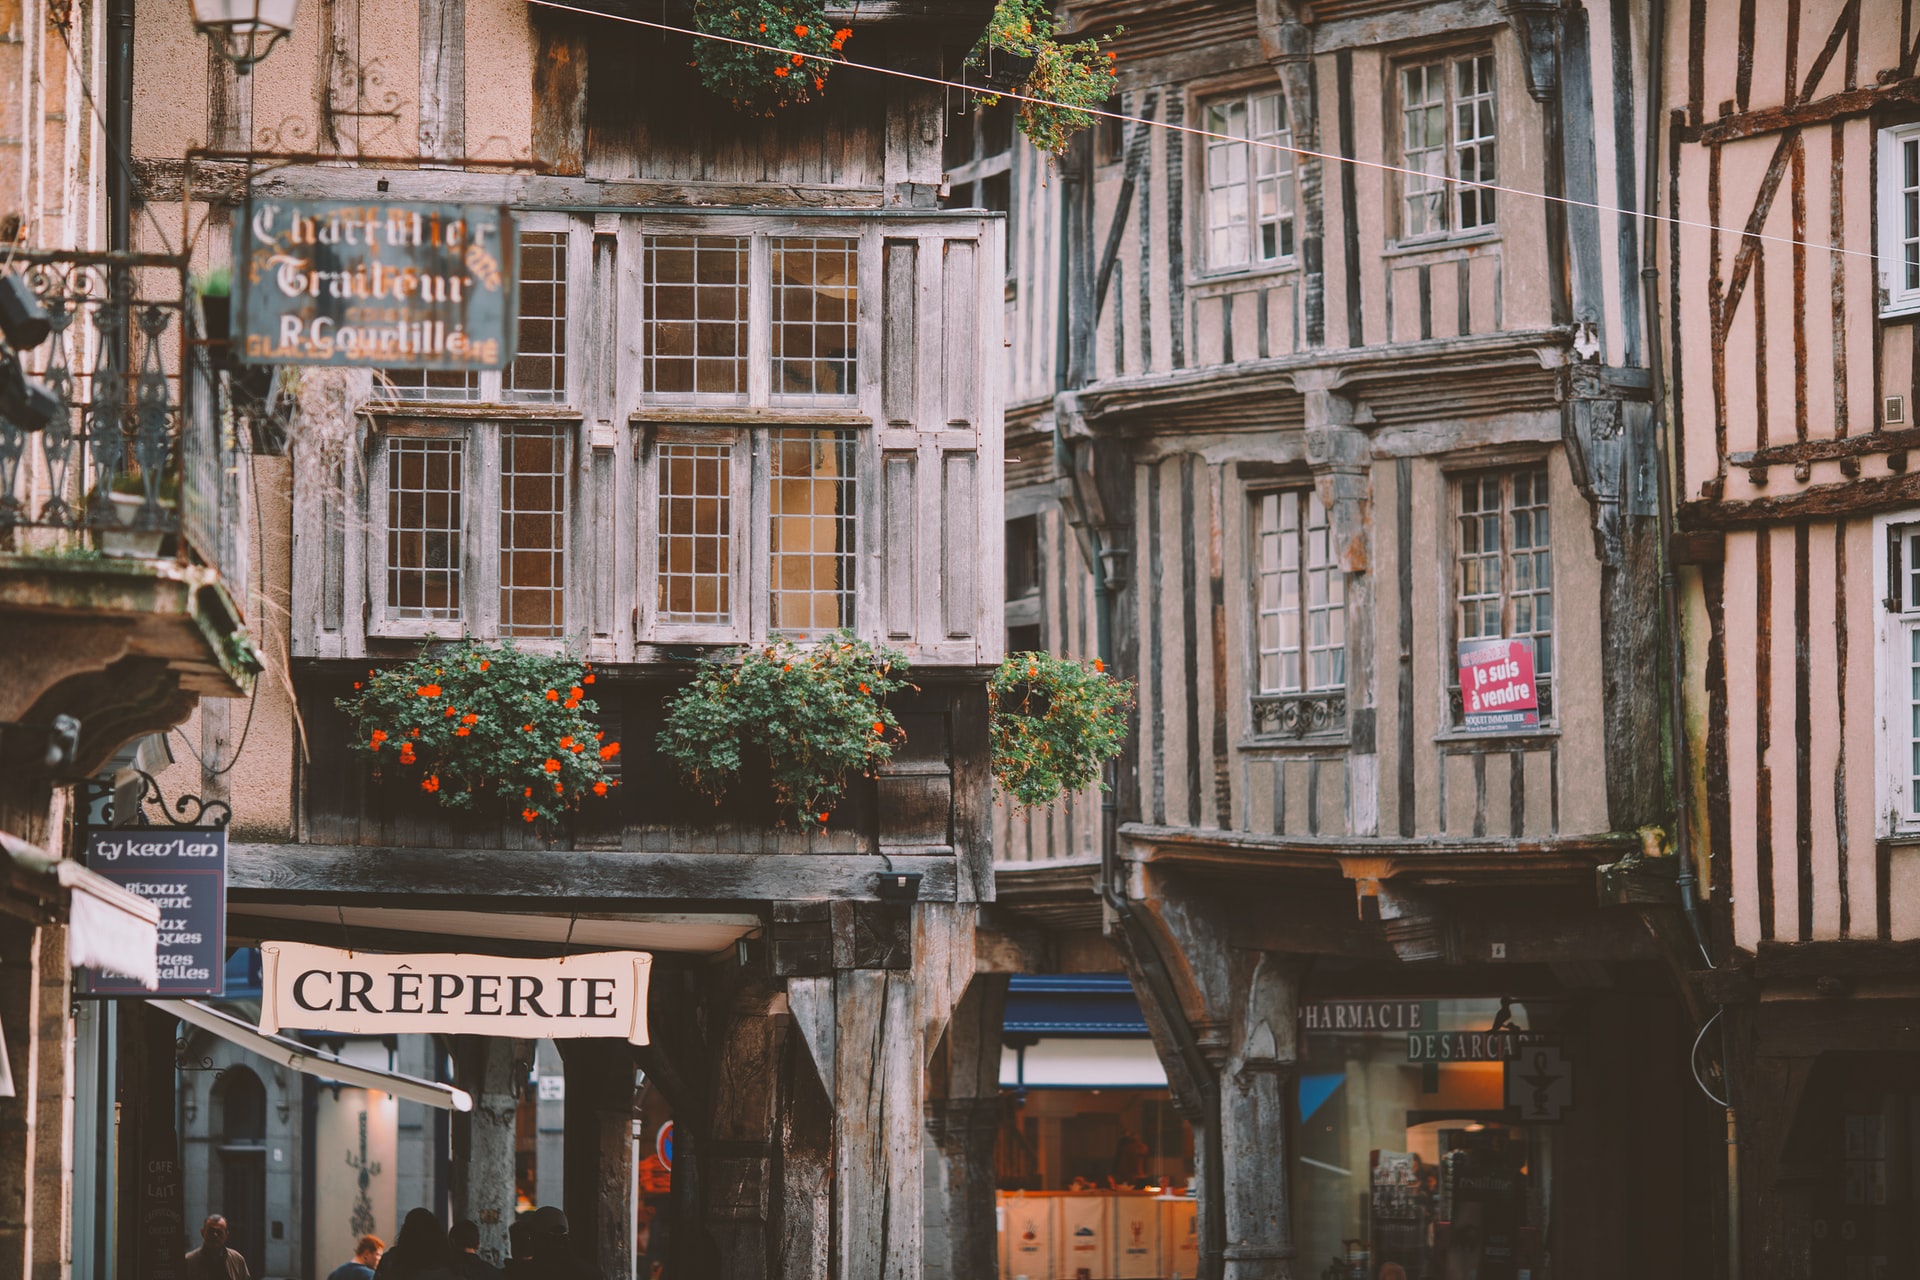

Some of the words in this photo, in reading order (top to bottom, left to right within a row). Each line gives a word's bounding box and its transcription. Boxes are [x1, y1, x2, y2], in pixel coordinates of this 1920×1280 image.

[266, 254, 473, 303] Traiteur
[1489, 658, 1519, 682] suis
[1472, 690, 1480, 710] à
[1481, 681, 1530, 708] vendre
[96, 840, 122, 861] ty
[292, 963, 617, 1018] CRÊPERIE
[1298, 1003, 1421, 1029] HARMACIE
[147, 1183, 177, 1198] LAIT
